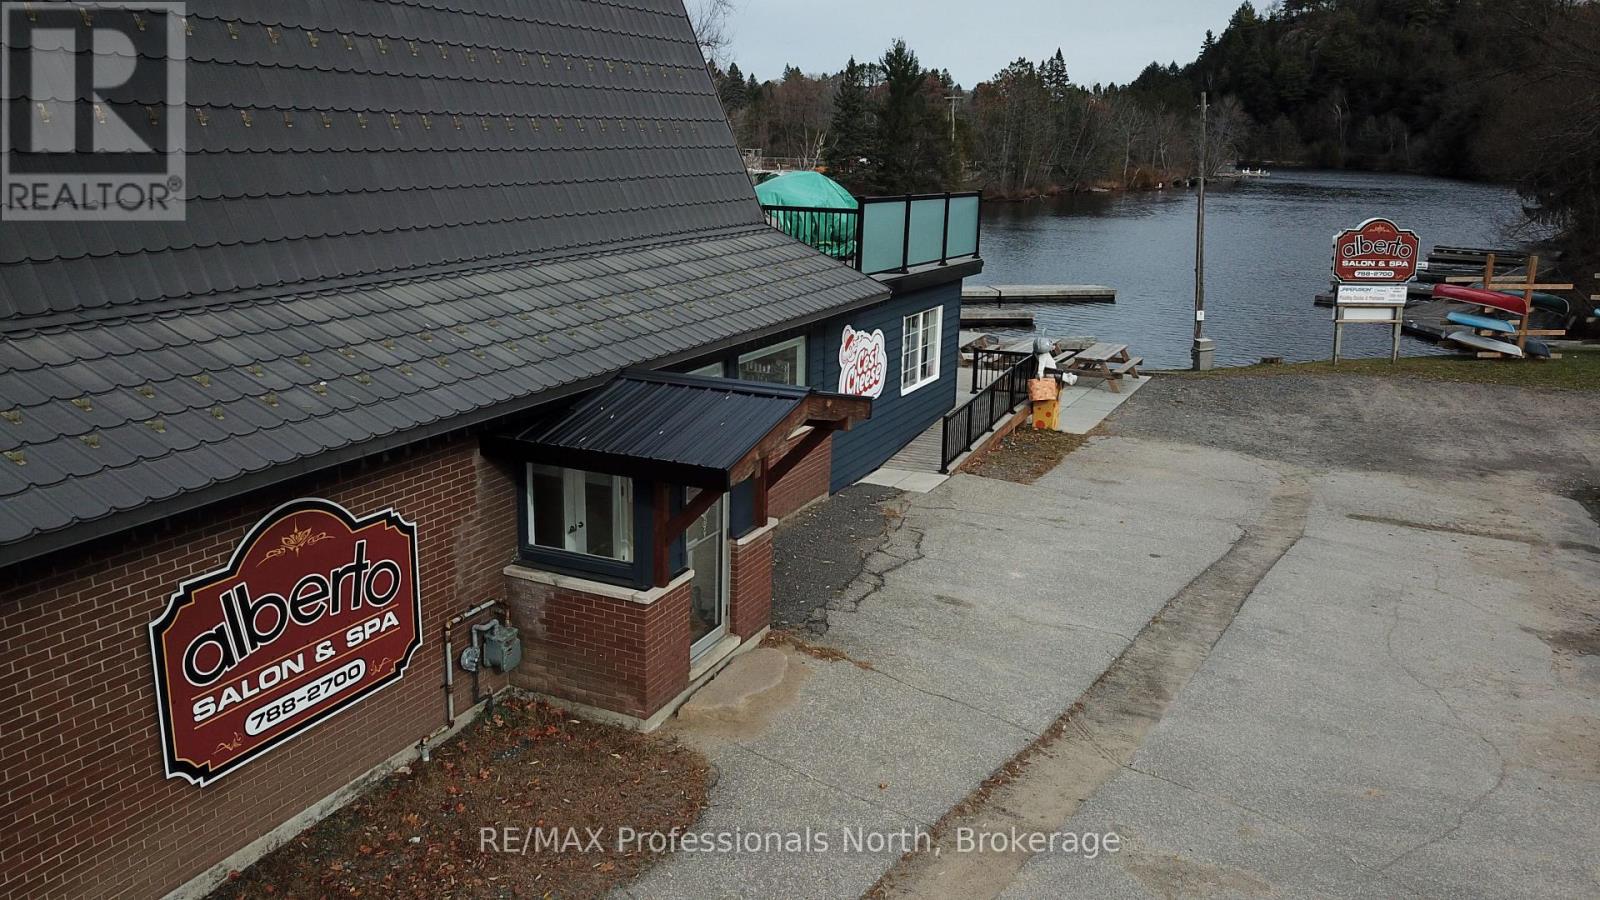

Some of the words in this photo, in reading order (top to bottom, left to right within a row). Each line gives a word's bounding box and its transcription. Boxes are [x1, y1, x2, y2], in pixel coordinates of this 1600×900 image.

[1342, 235, 1413, 258] alberto
[845, 362, 882, 396] Cheese
[182, 539, 402, 687] alberto
[192, 652, 305, 723] SALON
[314, 639, 336, 664] &
[345, 610, 400, 649] SPA
[250, 664, 362, 732] 788-2700
